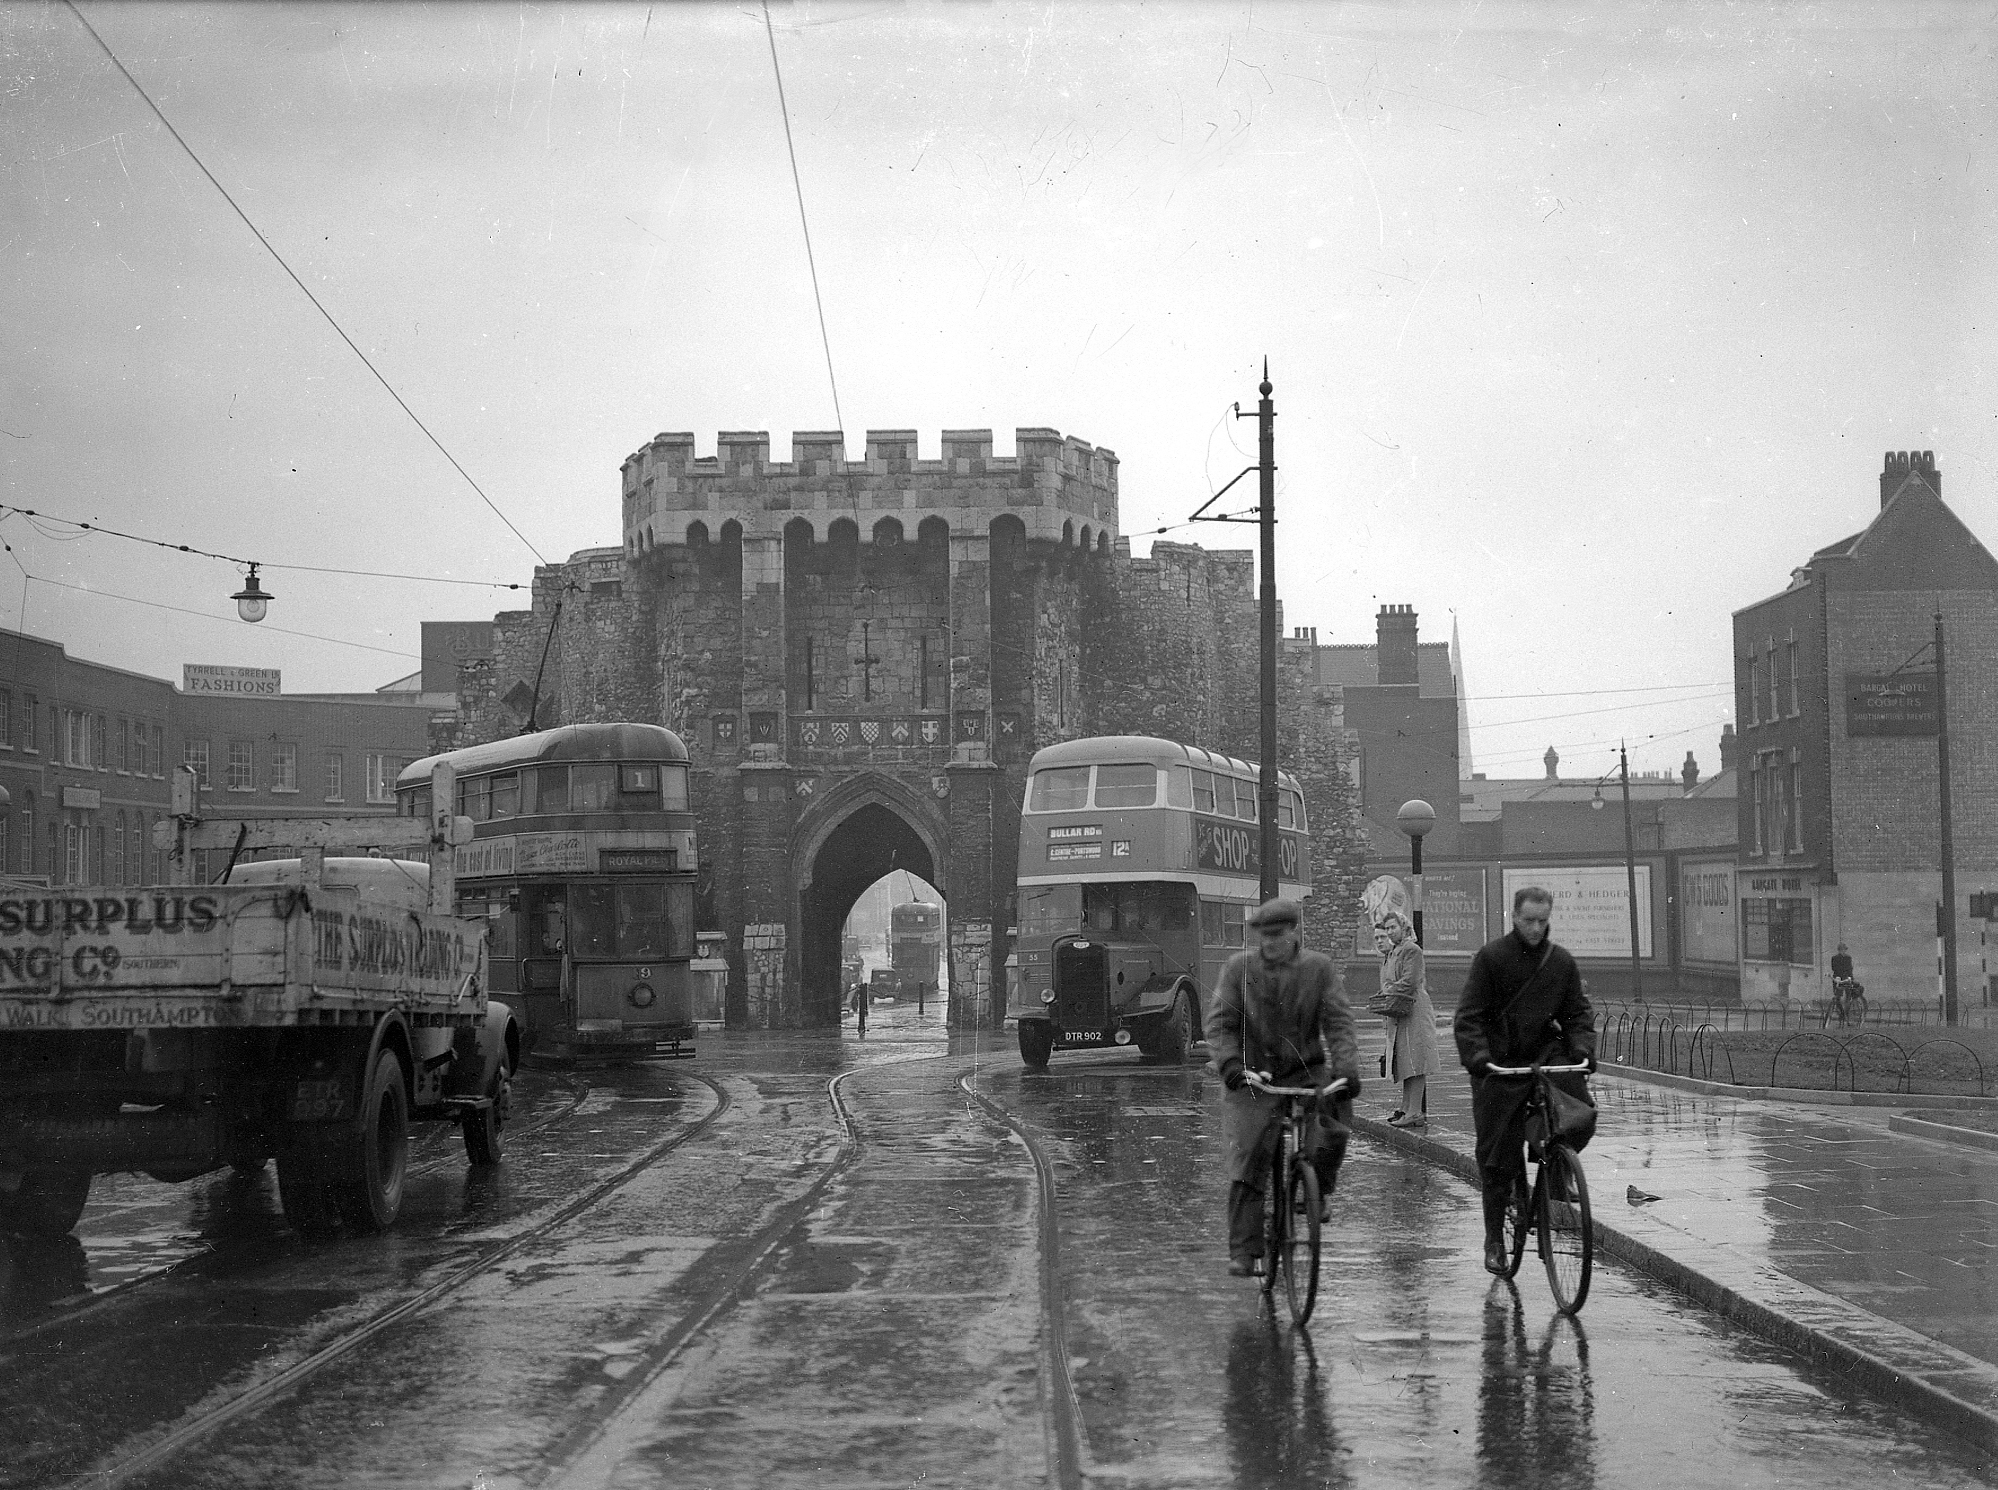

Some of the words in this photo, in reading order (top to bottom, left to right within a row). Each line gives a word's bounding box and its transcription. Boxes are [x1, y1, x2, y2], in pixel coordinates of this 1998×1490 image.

[187, 665, 226, 676] TYRRELL
[238, 668, 267, 678] GREEN
[190, 678, 274, 693] FASHIONS
[634, 772, 645, 788] 1
[1050, 828, 1082, 838] BULLAR
[1084, 827, 1095, 836] RD
[1112, 841, 1130, 856] 12A
[1213, 826, 1249, 870] SHOP
[494, 841, 513, 872] living
[609, 855, 641, 866] ROYAL
[0, 896, 218, 936] SURPLUS
[315, 908, 343, 971] THE
[350, 913, 404, 977] SURPLUS
[641, 967, 651, 978] 9
[81, 1004, 240, 1026] SOUTHAMPTON
[1065, 1032, 1083, 1040] DTR
[1084, 1032, 1102, 1040] 902
